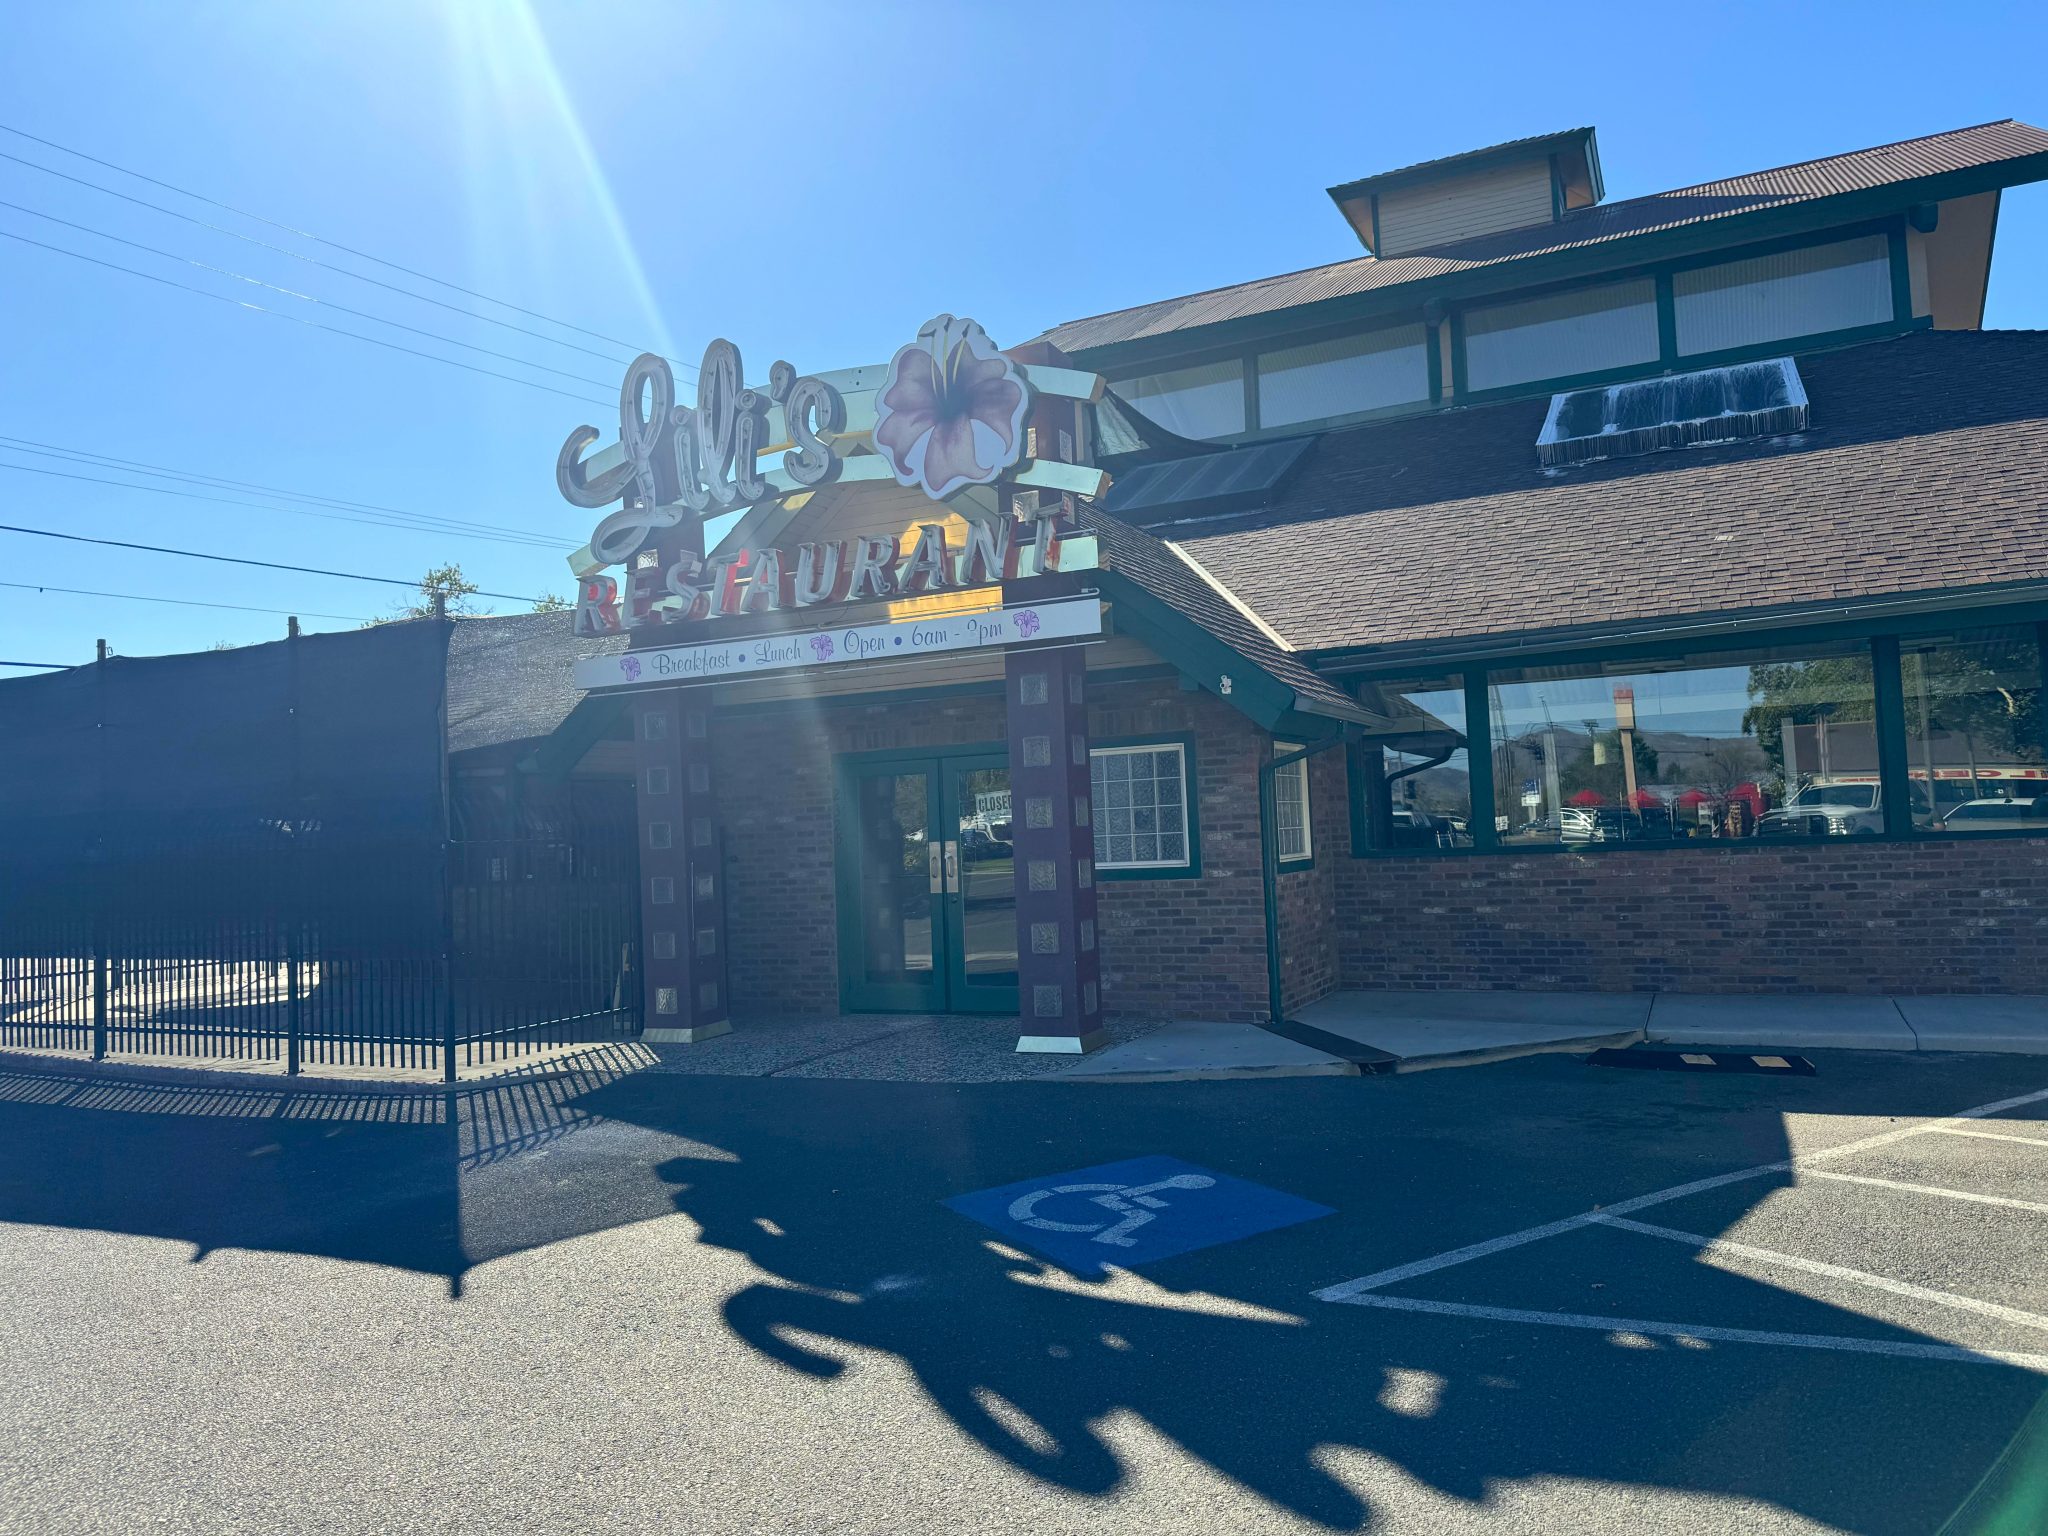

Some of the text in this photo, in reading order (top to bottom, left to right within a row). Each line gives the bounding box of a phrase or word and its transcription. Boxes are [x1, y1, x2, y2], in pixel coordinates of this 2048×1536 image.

[556, 338, 847, 565] Lili's
[574, 501, 1068, 635] RESTAURANT
[652, 649, 730, 675] Breakfast
[755, 639, 801, 664] Lunch
[844, 629, 885, 658] Open
[912, 625, 948, 646] 6am
